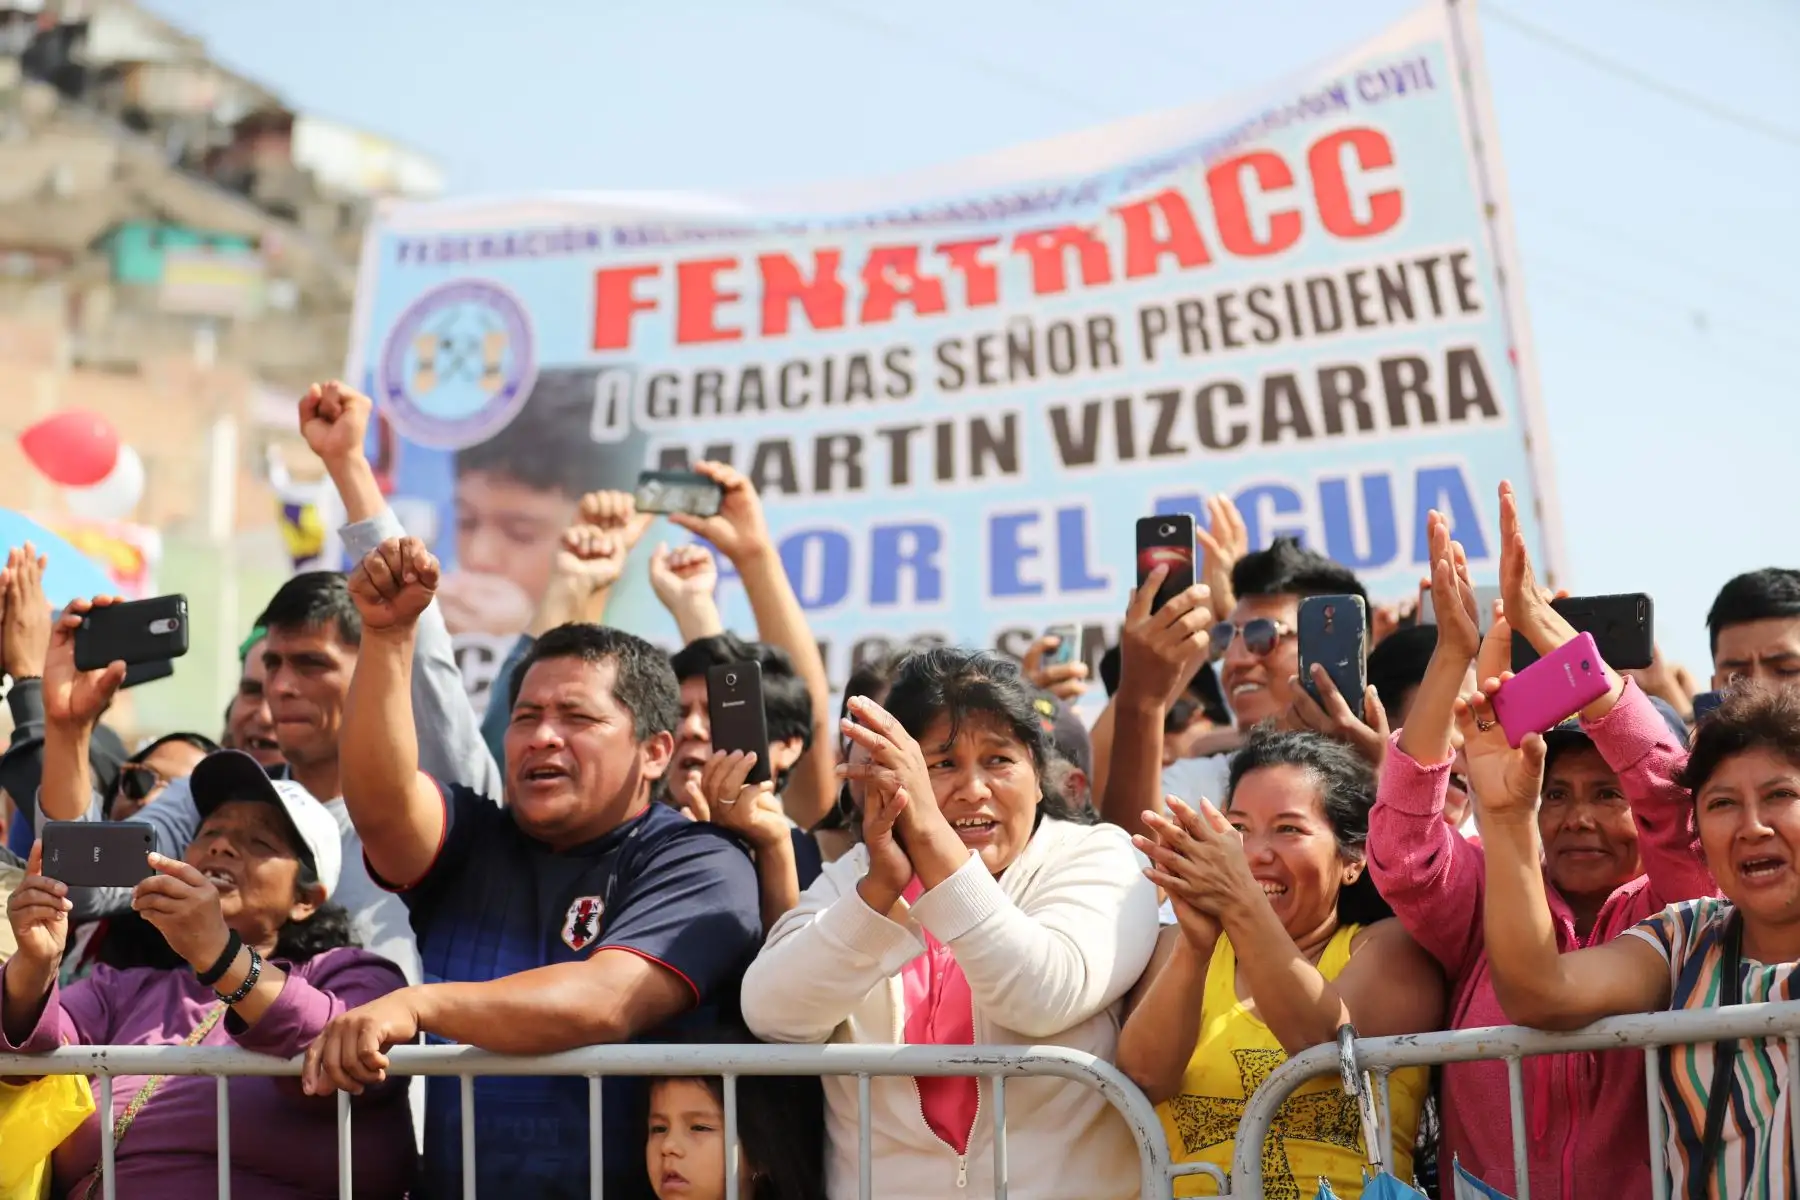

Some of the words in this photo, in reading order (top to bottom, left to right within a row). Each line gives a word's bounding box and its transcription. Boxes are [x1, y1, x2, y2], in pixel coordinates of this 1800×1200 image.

[937, 317, 1120, 392] SEÑOR
[1142, 250, 1481, 361] PRESIDENTE
[1049, 346, 1500, 467] VIZCARRA
[691, 523, 942, 610] OR
[989, 506, 1108, 597] EL
